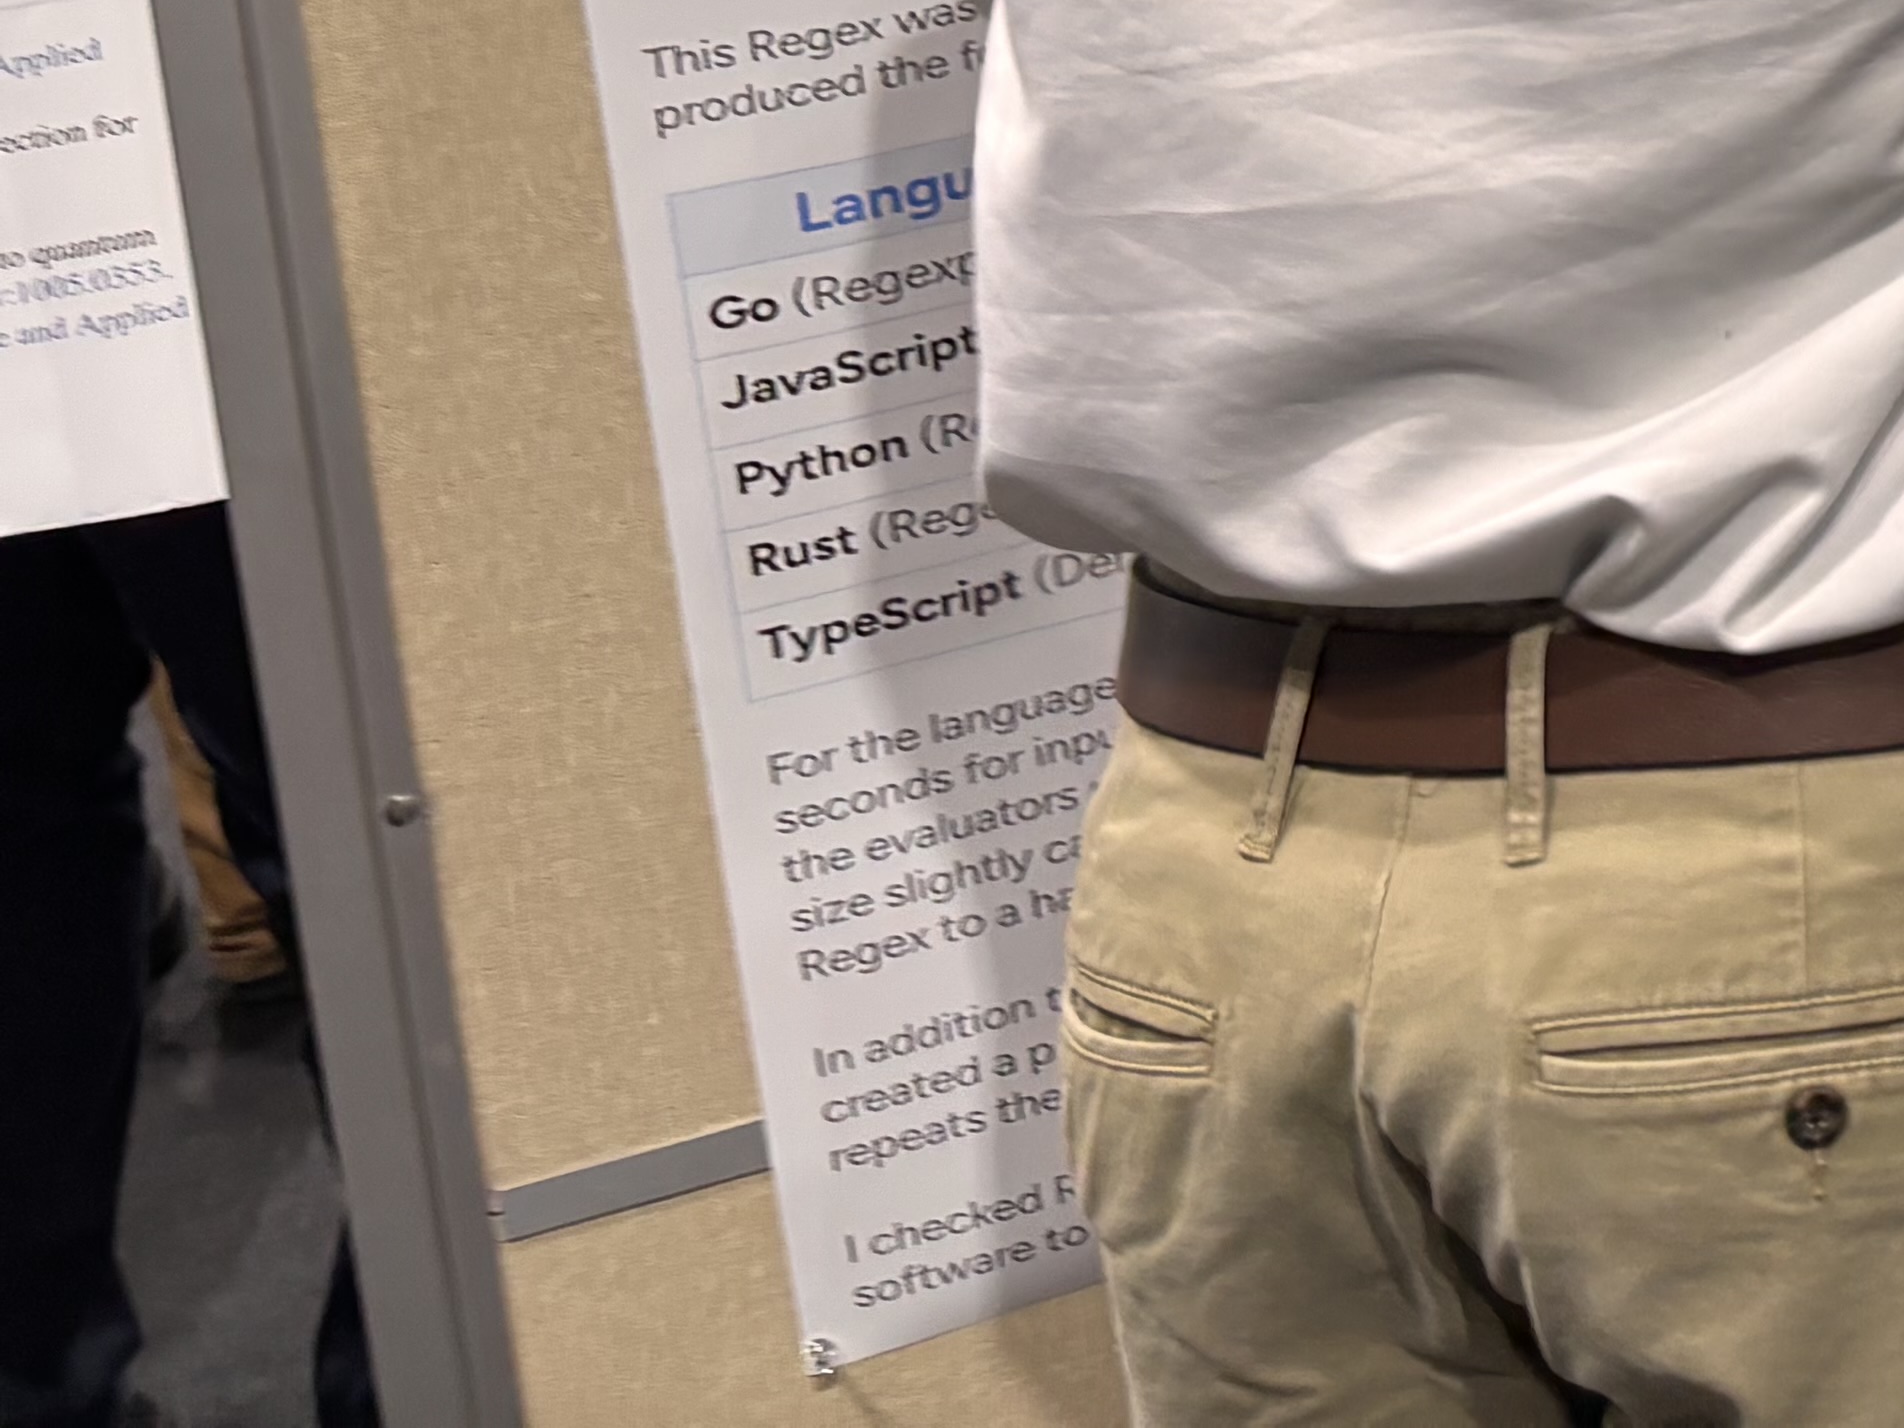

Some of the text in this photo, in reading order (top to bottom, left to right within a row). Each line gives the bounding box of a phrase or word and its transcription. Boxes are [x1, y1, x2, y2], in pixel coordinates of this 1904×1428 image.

[652, 53, 952, 138] produced the
[710, 291, 780, 329] Go
[721, 325, 980, 410] JavaScript
[735, 433, 909, 497] Python
[748, 526, 859, 576] Rust
[757, 570, 1023, 663] TypeScript
[773, 771, 953, 834] seconds
[865, 789, 1078, 861] evaluators
